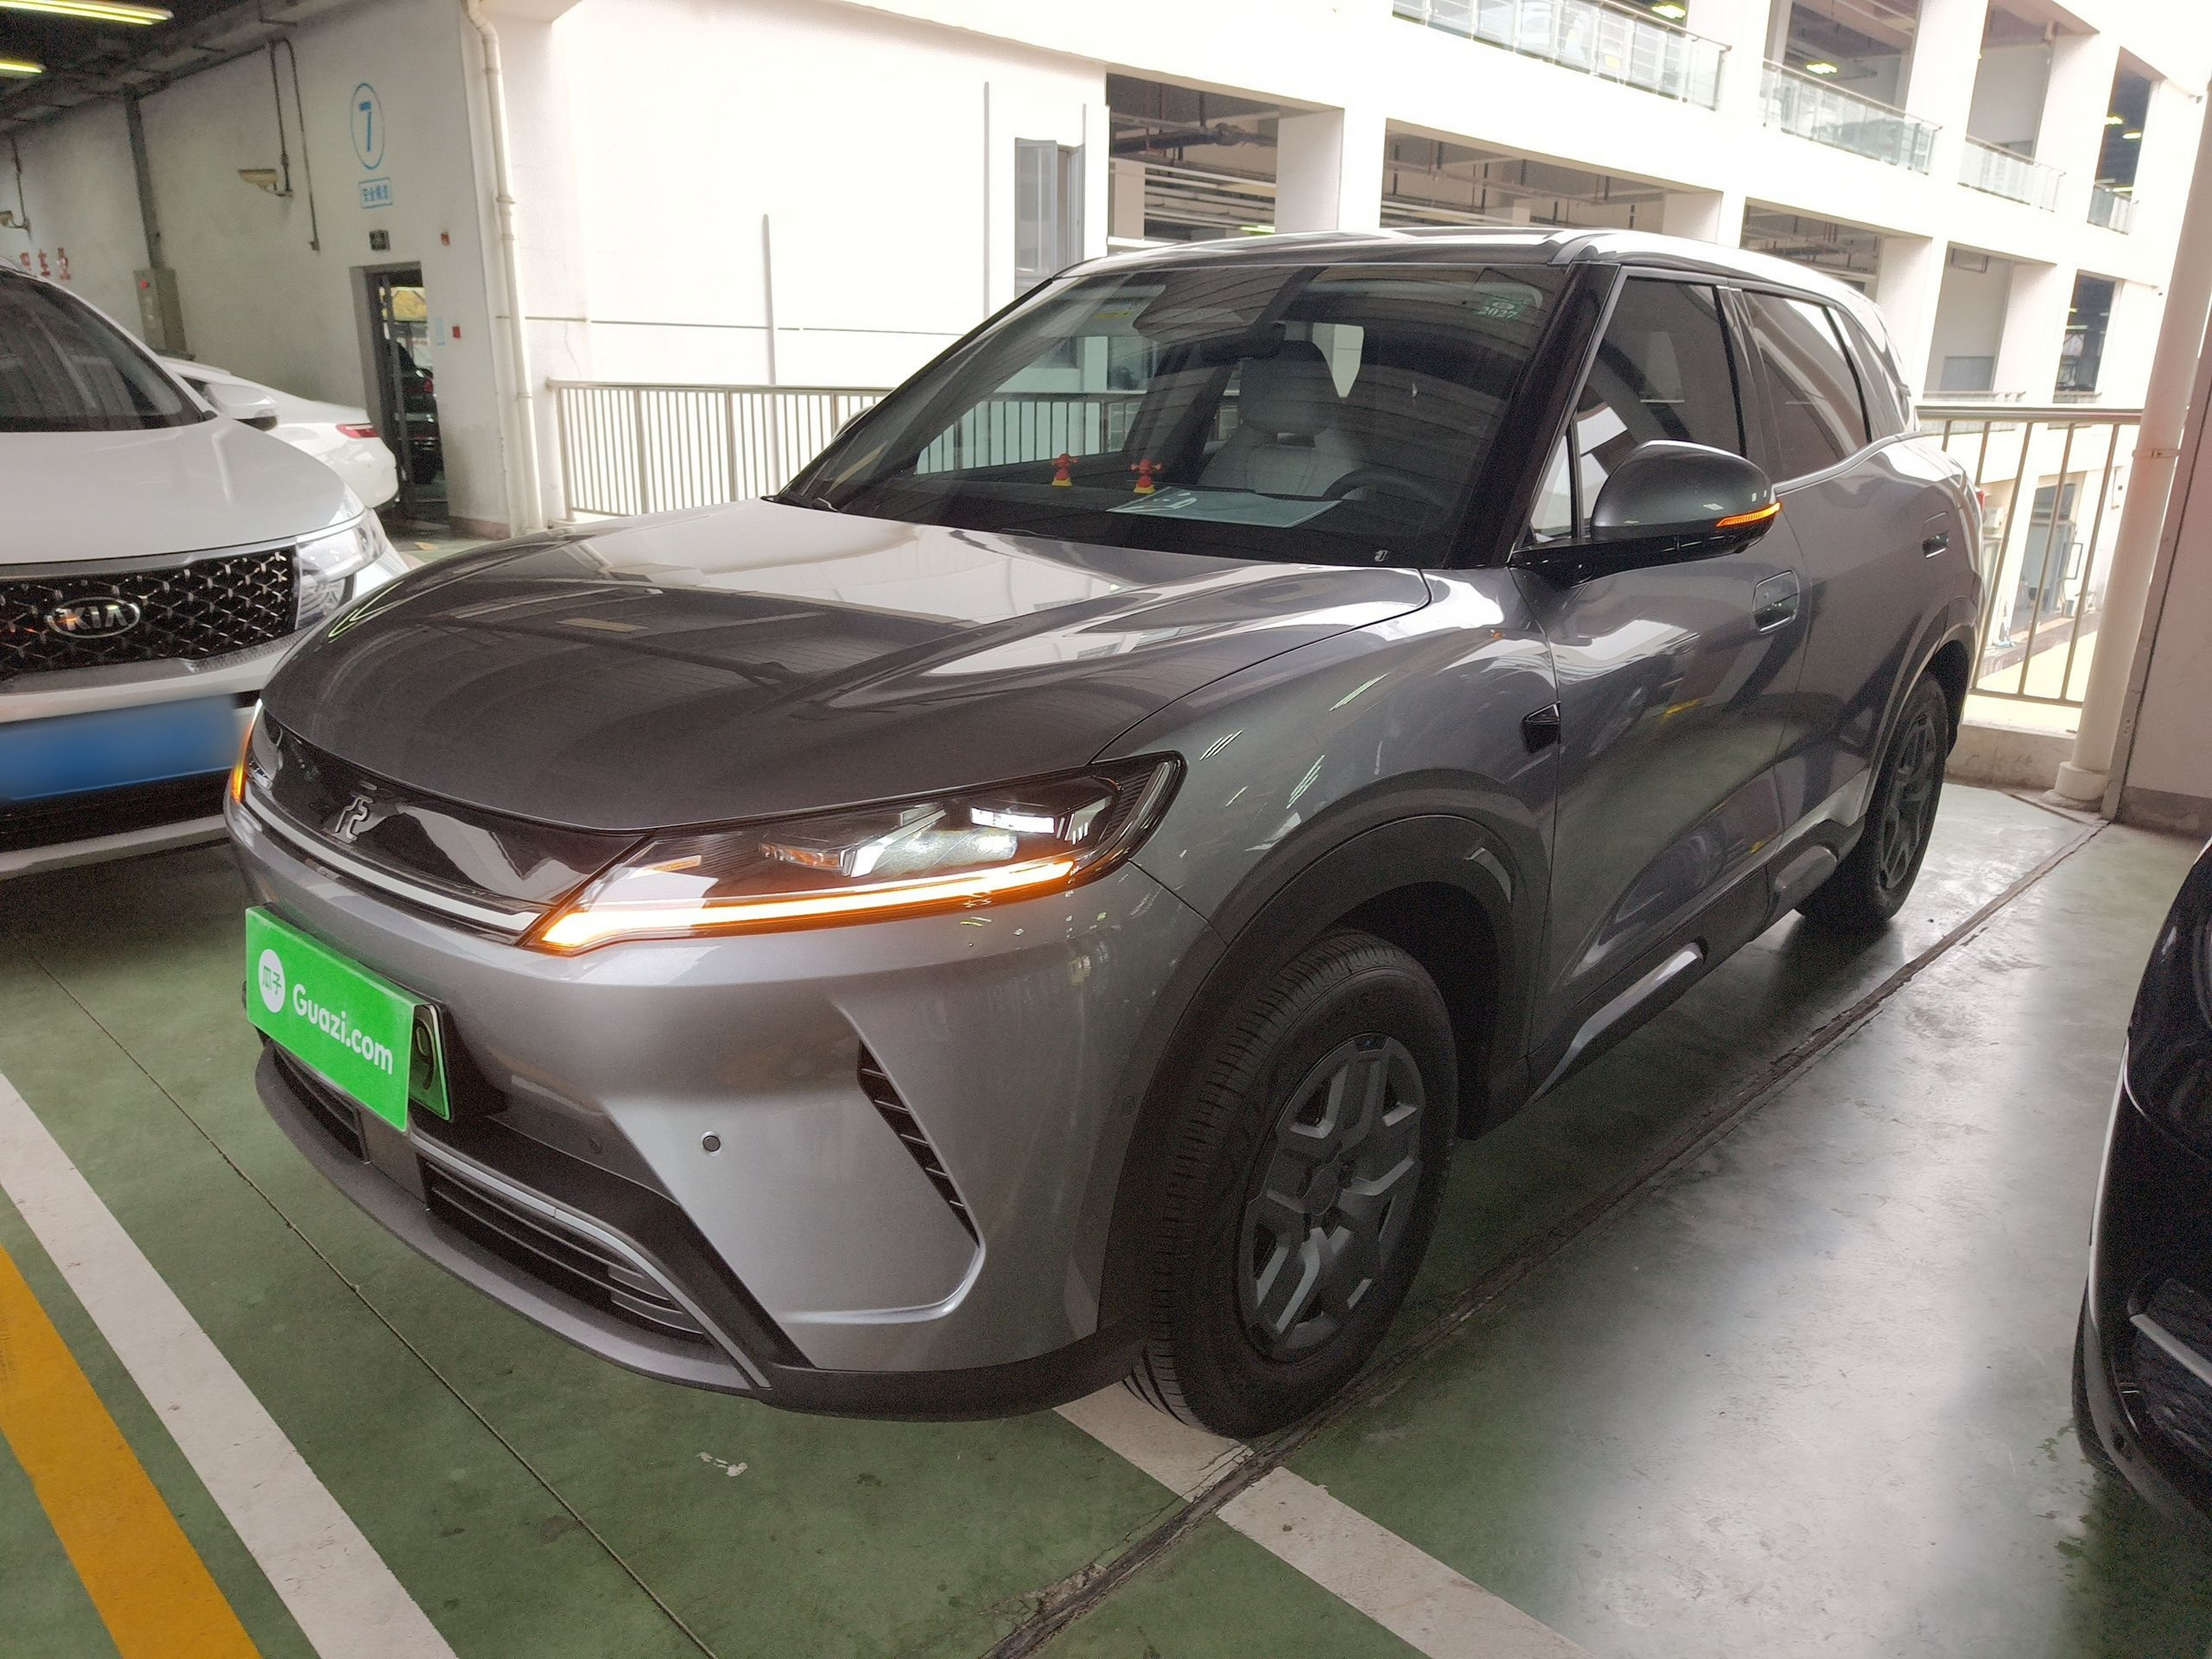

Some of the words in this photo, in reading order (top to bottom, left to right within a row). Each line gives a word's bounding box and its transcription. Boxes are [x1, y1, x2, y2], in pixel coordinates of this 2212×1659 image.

[358, 101, 373, 152] 7
[1476, 306, 1519, 320] 2027
[56, 605, 128, 631] KIA
[263, 965, 282, 995] 瓜子
[293, 983, 393, 1075] Guazi.com
